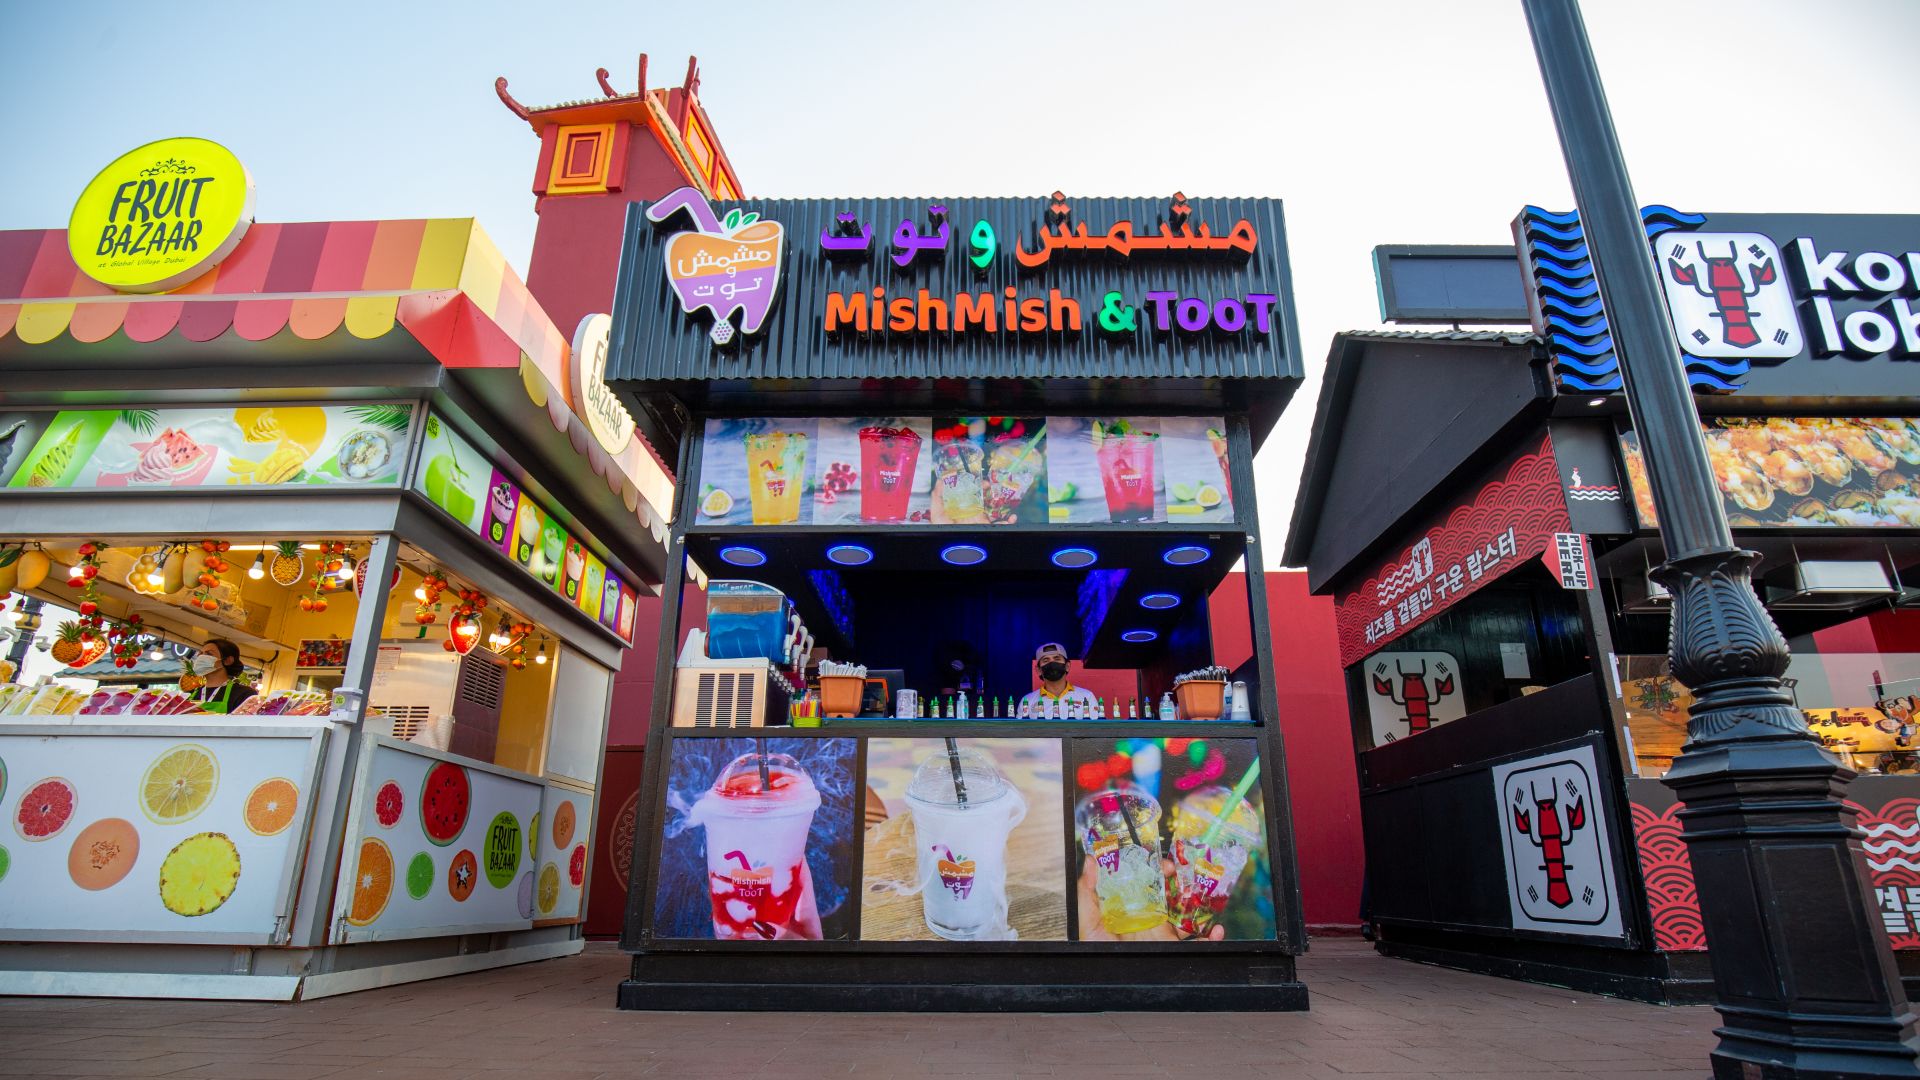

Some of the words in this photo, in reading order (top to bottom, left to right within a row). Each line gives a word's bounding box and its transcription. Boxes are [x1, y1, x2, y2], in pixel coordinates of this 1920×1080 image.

[108, 177, 215, 223] FRUIT
[96, 219, 203, 258] BAZAAR
[820, 204, 949, 266] توت
[969, 219, 996, 268] و
[1015, 190, 1258, 267] مشمش
[678, 245, 772, 277] مشمش
[693, 277, 763, 301] توت
[824, 286, 1082, 333] MishMish
[1099, 291, 1138, 333] &
[588, 373, 623, 440] BAZAAR
[1556, 534, 1575, 587] HERE
[1570, 535, 1588, 587] PICK-UP
[1364, 609, 1396, 644] 치즈를
[1435, 563, 1464, 600] 구운
[1466, 526, 1517, 582] 랍스터
[489, 851, 516, 872] BAZAAR
[492, 825, 518, 851] FRUIT
